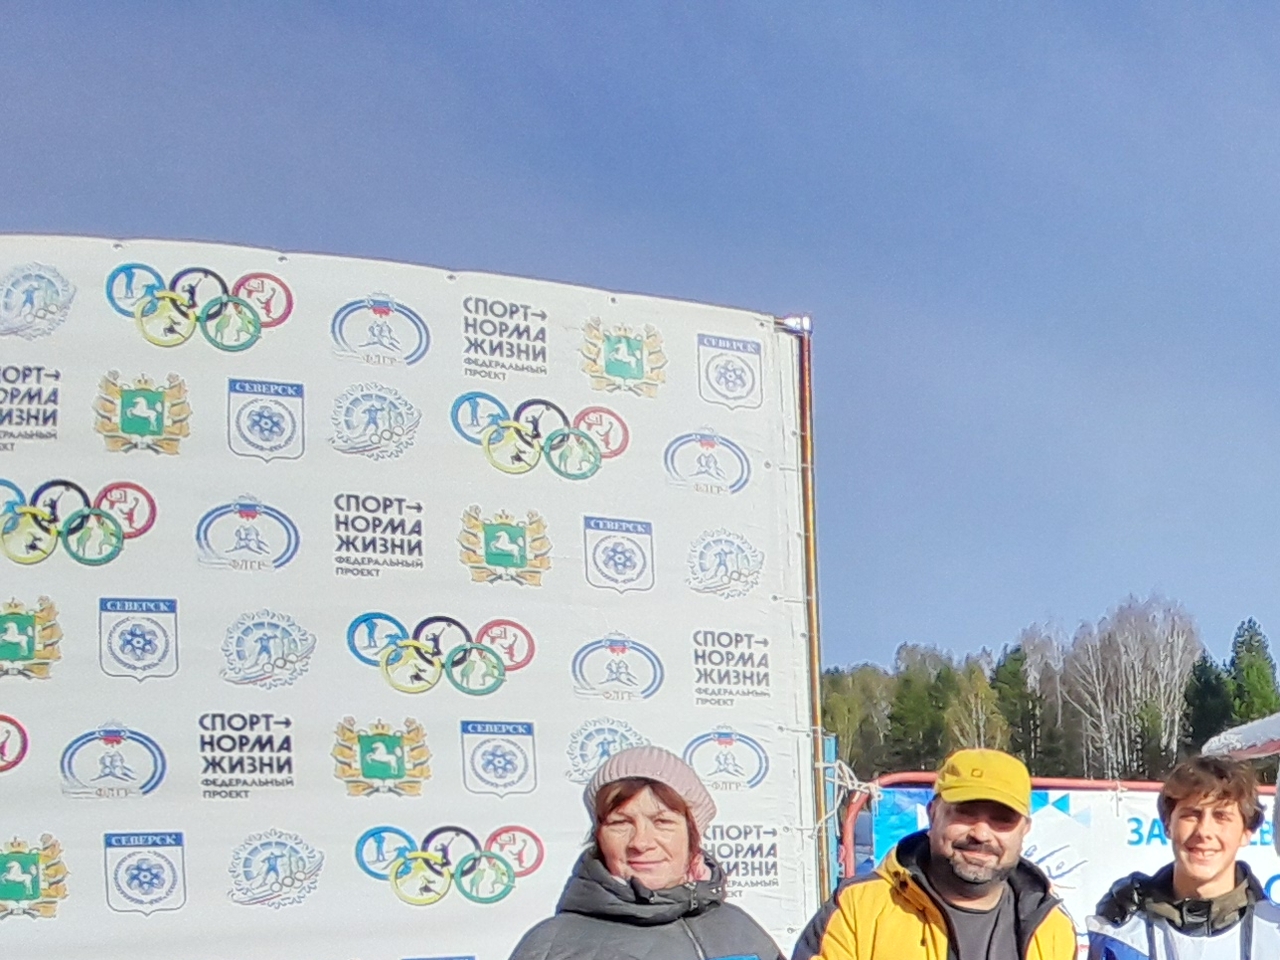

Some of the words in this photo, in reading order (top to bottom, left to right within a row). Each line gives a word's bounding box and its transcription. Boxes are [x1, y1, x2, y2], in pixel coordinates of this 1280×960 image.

[463, 296, 531, 322] СПОРТ
[464, 315, 546, 344] НОРМА
[463, 335, 546, 363] ЖИЗНИ
[0, 365, 45, 384] ОРТ
[463, 357, 547, 375] ФЕДЕРАЛЬНЫЙ
[464, 368, 506, 381] ПРОЕКТ
[235, 381, 298, 396] СЕВЕРСК
[0, 408, 57, 426] ИЗНИ
[334, 493, 406, 515] СПОРТ
[335, 513, 422, 537] НОРМА
[590, 519, 646, 533] СЕВЕРСК
[335, 534, 423, 557] ЖИЗНИ
[335, 556, 423, 569] ФЕДЕРАЛЬНЫЙ
[335, 566, 380, 577] ПРОЕКТ
[106, 601, 172, 611] СЕВЕРСК
[692, 630, 755, 649] СПОРТ
[694, 648, 769, 669] НОРМА
[695, 667, 770, 687] ЖИЗНИ
[695, 697, 734, 706] ПРОЕКТ
[198, 713, 274, 732] СПОРТ
[467, 723, 528, 734] СЕВЕРСК
[200, 734, 292, 753] НОРМА
[201, 755, 293, 774] ЖИЗНИ
[201, 776, 294, 787] ФЕДЕРАЛЬНЫЙ
[203, 790, 250, 799] ПРОЕКТ
[111, 834, 176, 845] СЕВЕРСК
[703, 824, 763, 841] СПОРТ
[703, 842, 777, 859] НОРМА
[722, 861, 778, 877] ИЗНИ
[727, 878, 779, 888] ЕРАЛЬНЫЙ
